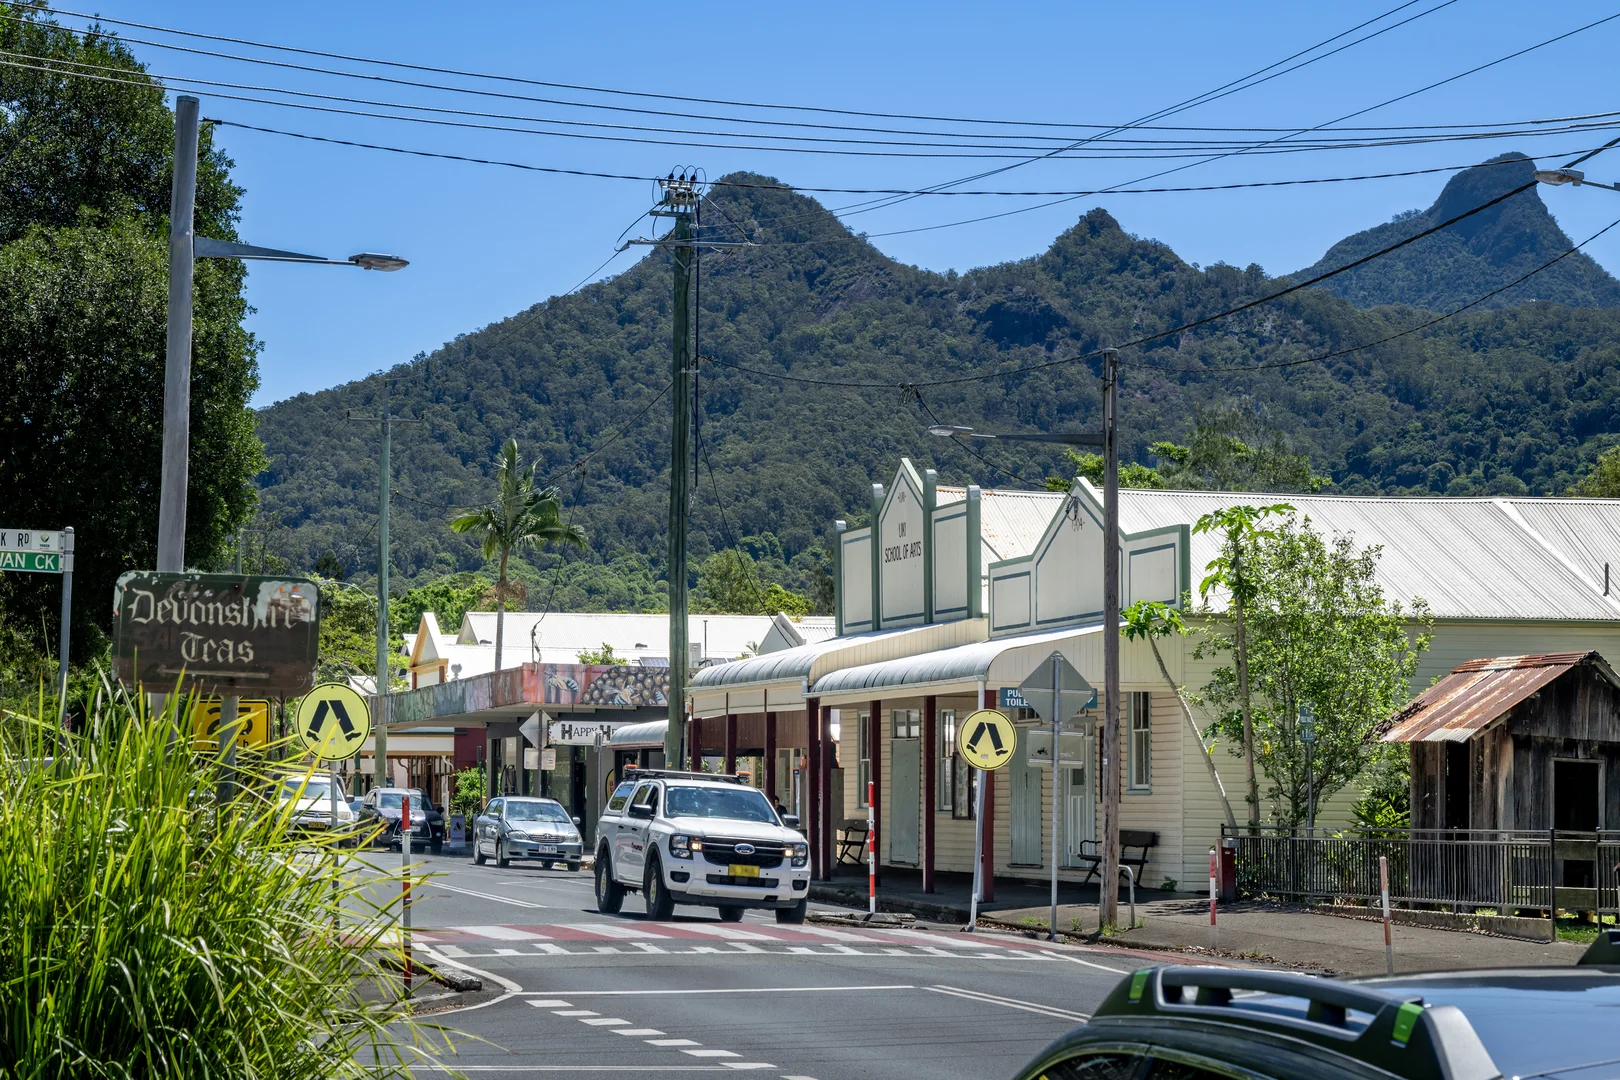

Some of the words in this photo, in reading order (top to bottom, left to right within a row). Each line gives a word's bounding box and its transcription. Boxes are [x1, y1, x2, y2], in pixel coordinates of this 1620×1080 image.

[0, 532, 7, 547] K
[17, 532, 30, 547] RD
[885, 545, 902, 563] SCHOOL
[902, 543, 909, 559] OF
[910, 541, 922, 558] ARTS
[34, 554, 55, 570] CK
[180, 632, 254, 664] Teas
